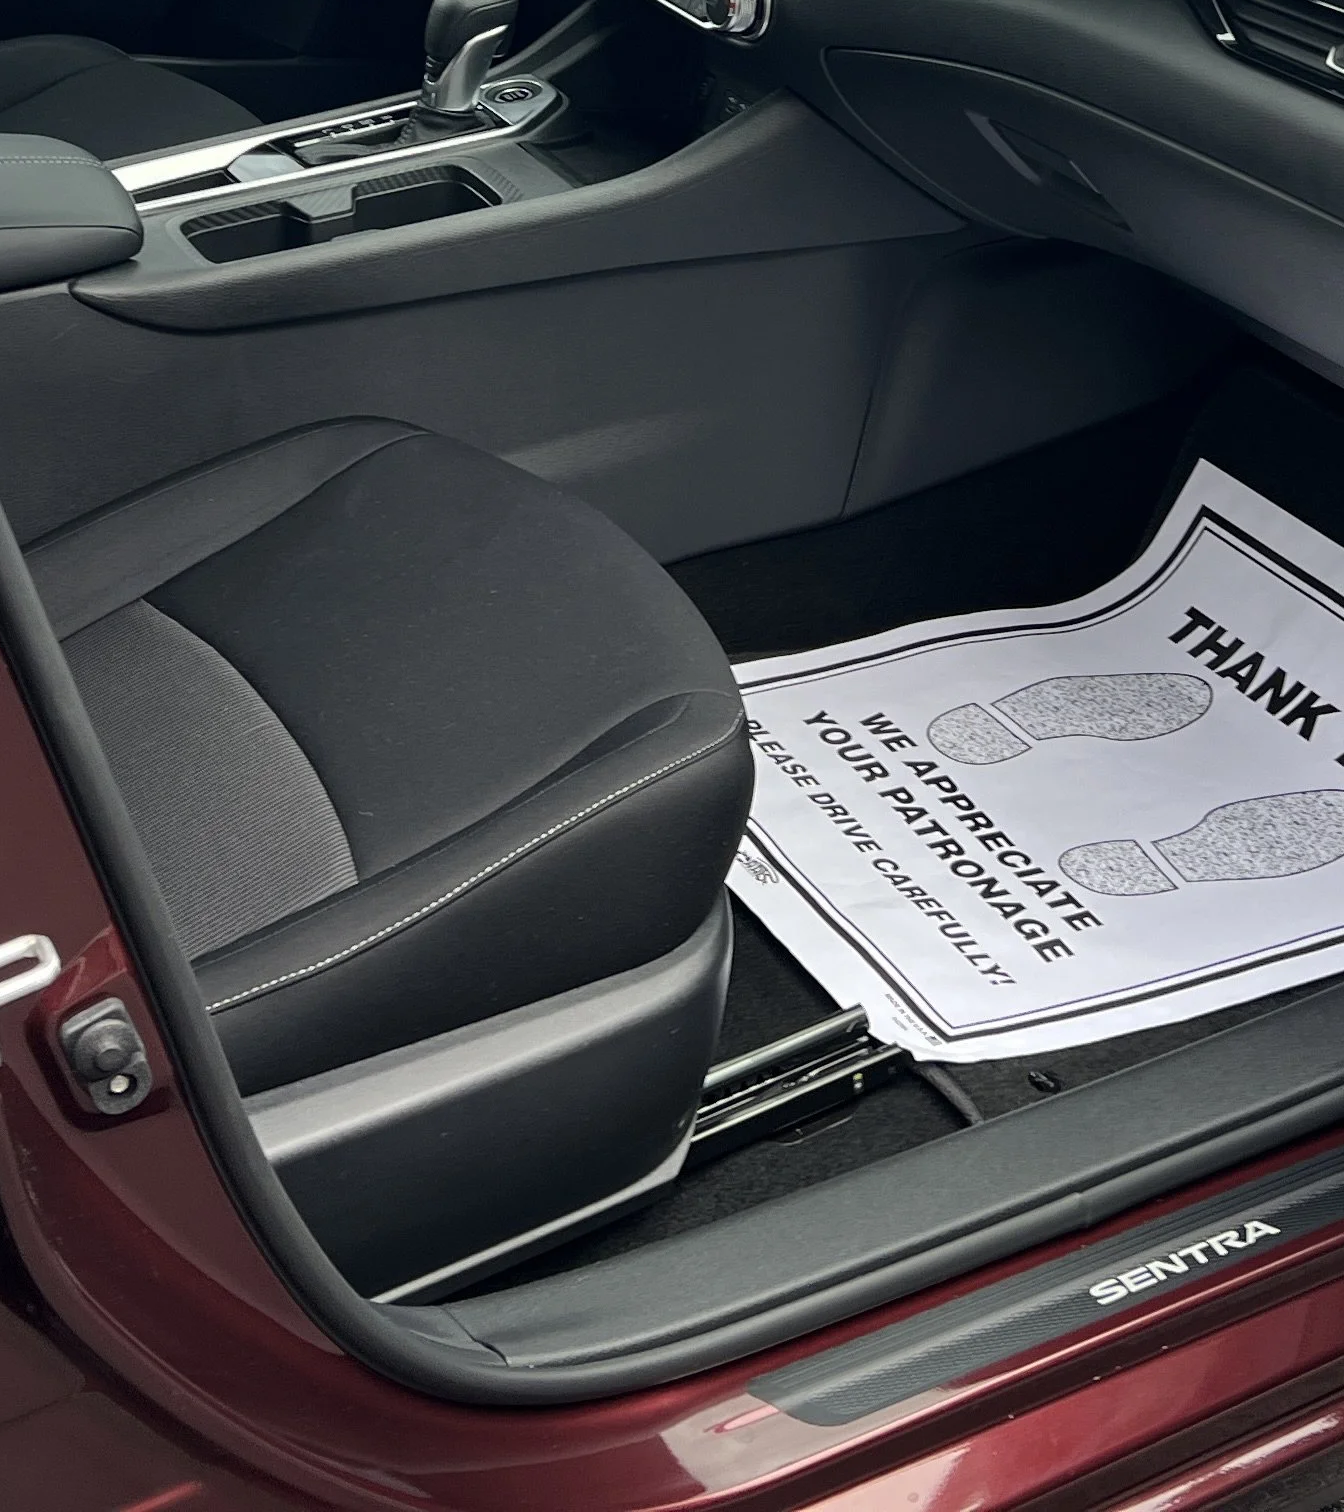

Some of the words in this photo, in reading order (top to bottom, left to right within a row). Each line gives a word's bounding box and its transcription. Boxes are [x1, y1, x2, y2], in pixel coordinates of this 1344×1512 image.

[1168, 605, 1342, 742] THANK
[802, 710, 890, 783] YOUR
[878, 786, 1074, 963] PATRONAGE
[808, 792, 883, 853] DRIVE
[872, 858, 1018, 987] CAREFULLY!
[859, 712, 919, 753] WE
[903, 761, 1104, 932] APPRECIATE
[1088, 1219, 1282, 1306] SENTRA
